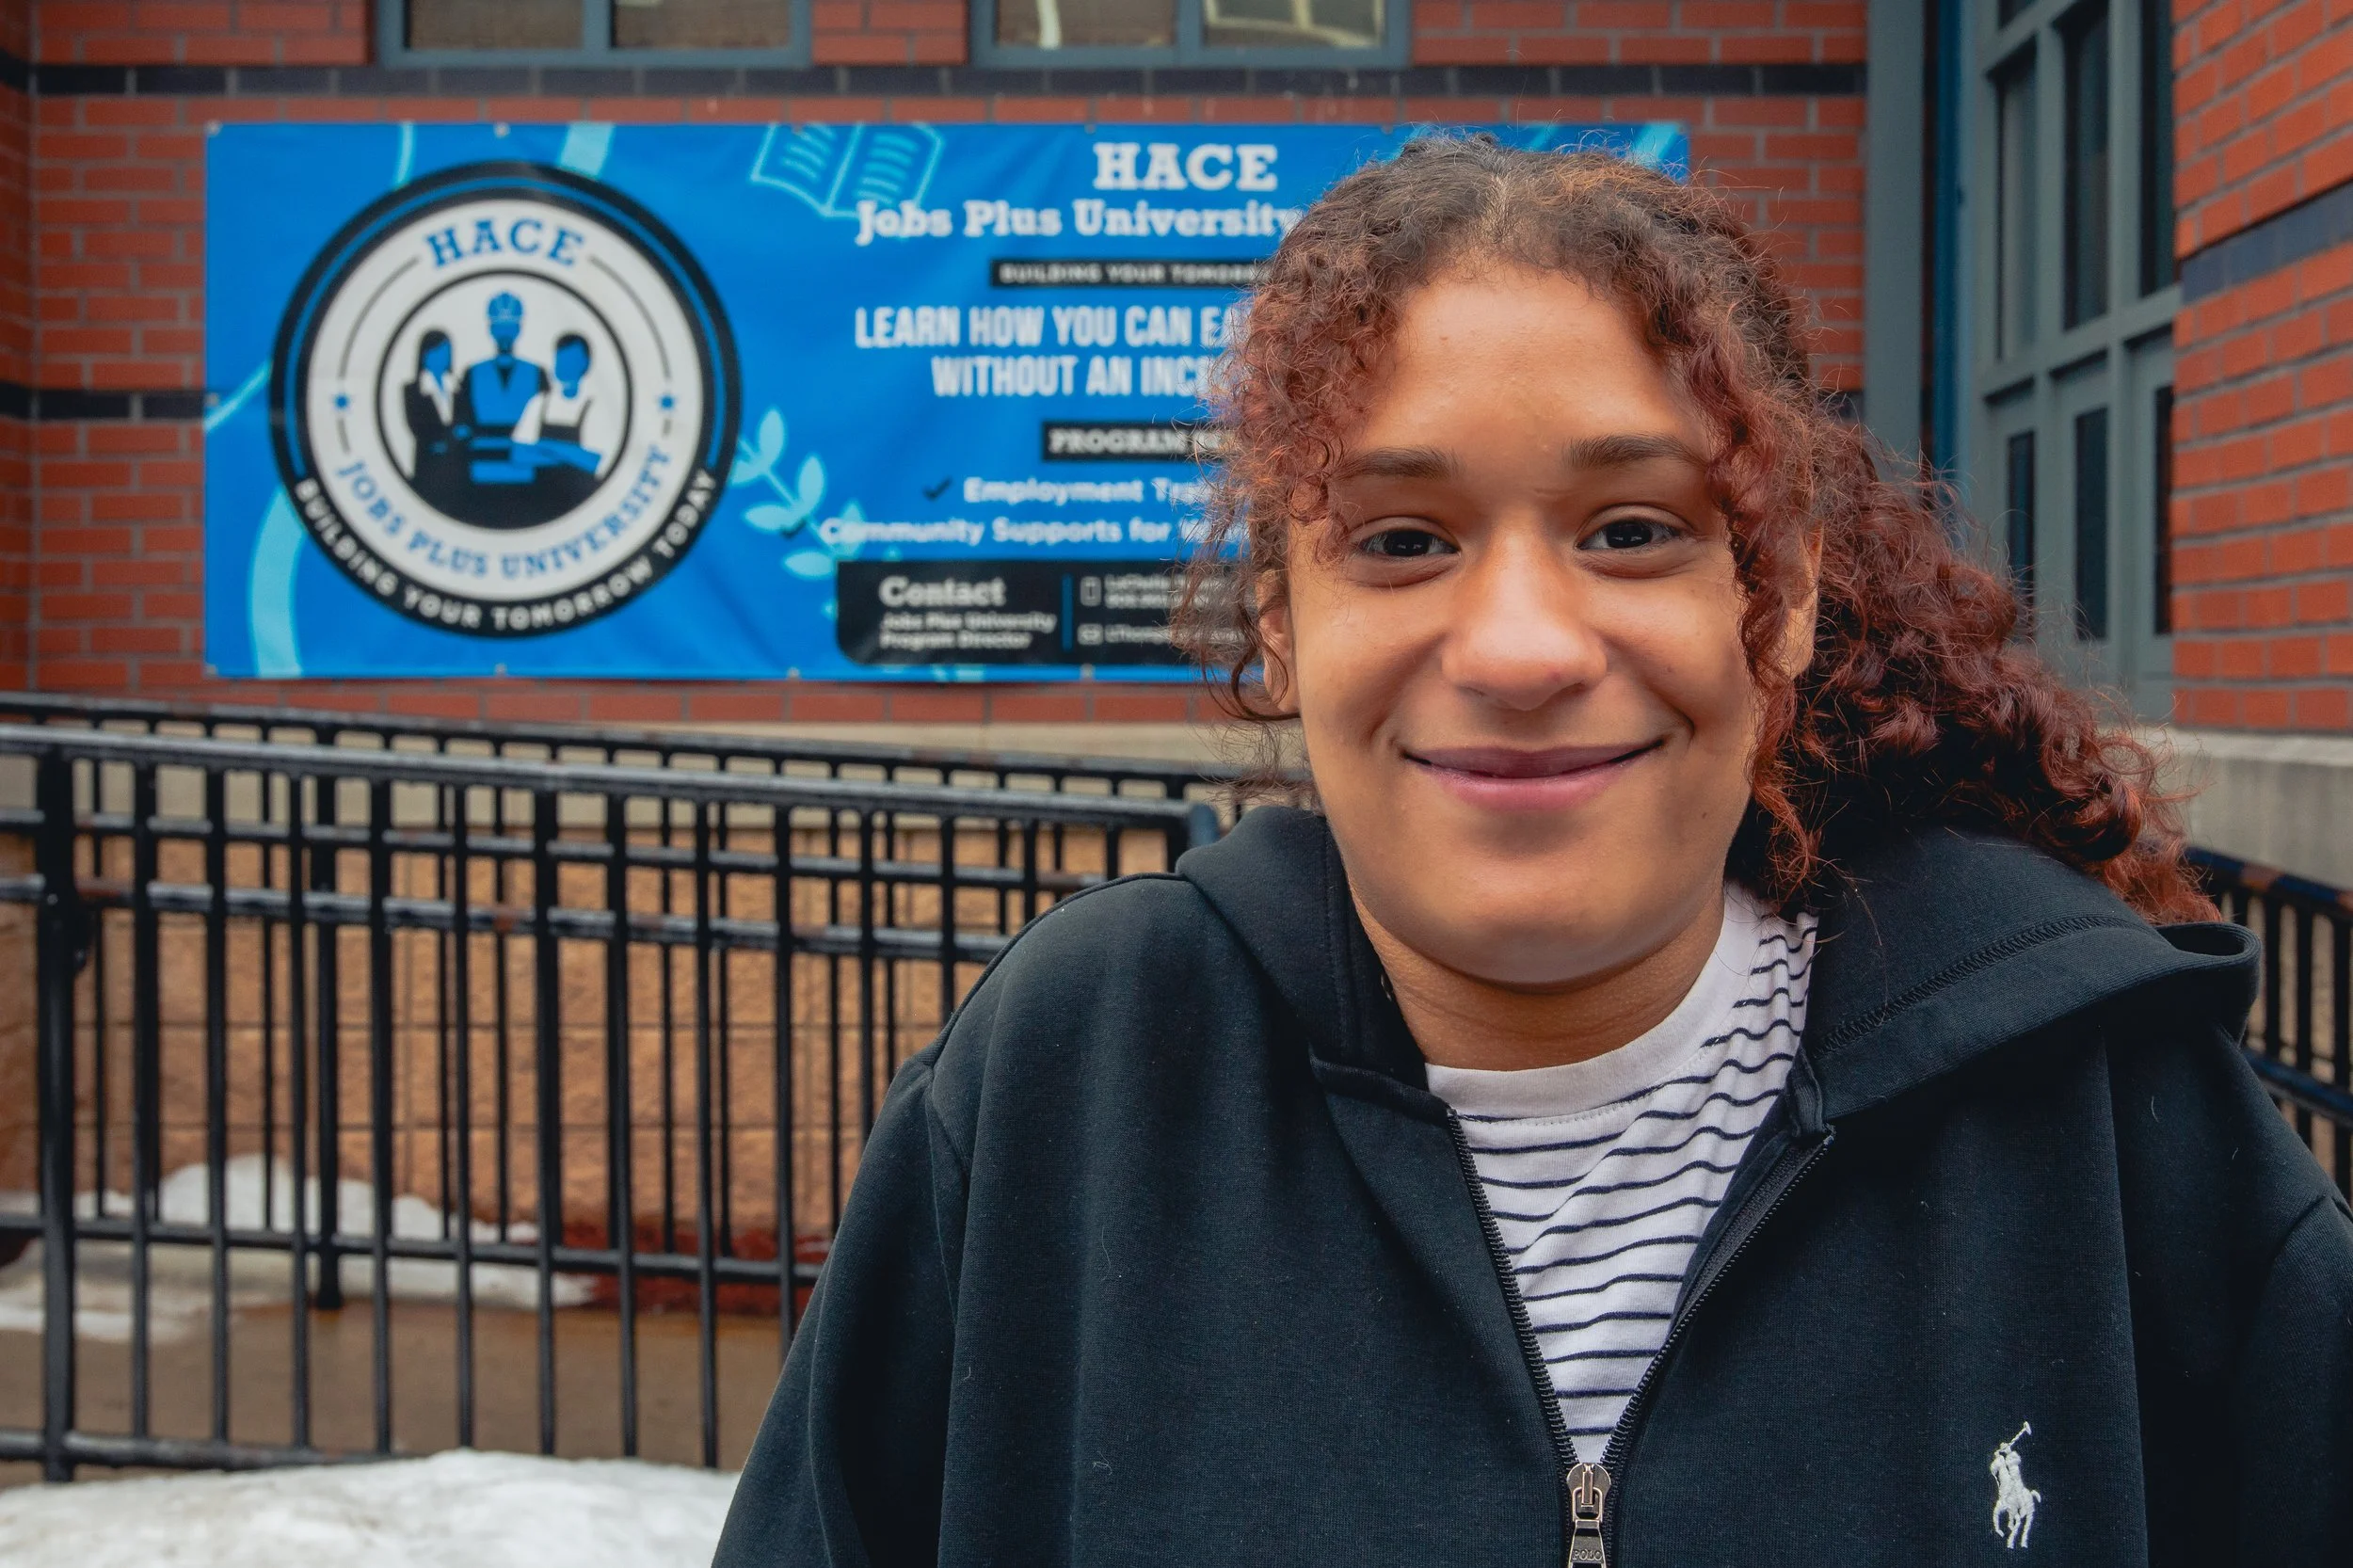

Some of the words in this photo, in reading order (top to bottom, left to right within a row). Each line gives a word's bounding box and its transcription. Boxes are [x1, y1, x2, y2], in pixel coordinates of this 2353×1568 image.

[1093, 142, 1278, 191] HACE
[426, 217, 584, 268] HACE
[855, 200, 952, 247] Jobs
[963, 200, 1063, 236] Plus
[1071, 199, 1304, 243] University
[998, 263, 1102, 283] BUILDING
[1106, 263, 1166, 283] YOUR
[855, 306, 961, 349] LEARN
[968, 305, 1045, 347] HOW
[1051, 305, 1117, 347] YOU
[1124, 305, 1193, 347] CAN
[931, 354, 1080, 397] WITHOUT
[1085, 355, 1132, 396] AN
[336, 459, 405, 537] JOBS
[408, 531, 488, 578] PLUS
[500, 444, 670, 579] UNIVERSITY
[963, 476, 1144, 506] Employment
[296, 477, 399, 597] BUILDING
[404, 584, 483, 629] YOUR
[491, 555, 653, 631] TOMORROW
[651, 469, 716, 558] TODAY
[819, 517, 984, 547] Community
[992, 515, 1122, 545] Supports
[1129, 516, 1171, 543] for
[878, 575, 1007, 608] Contact
[1572, 1549, 1603, 1560] POLO
